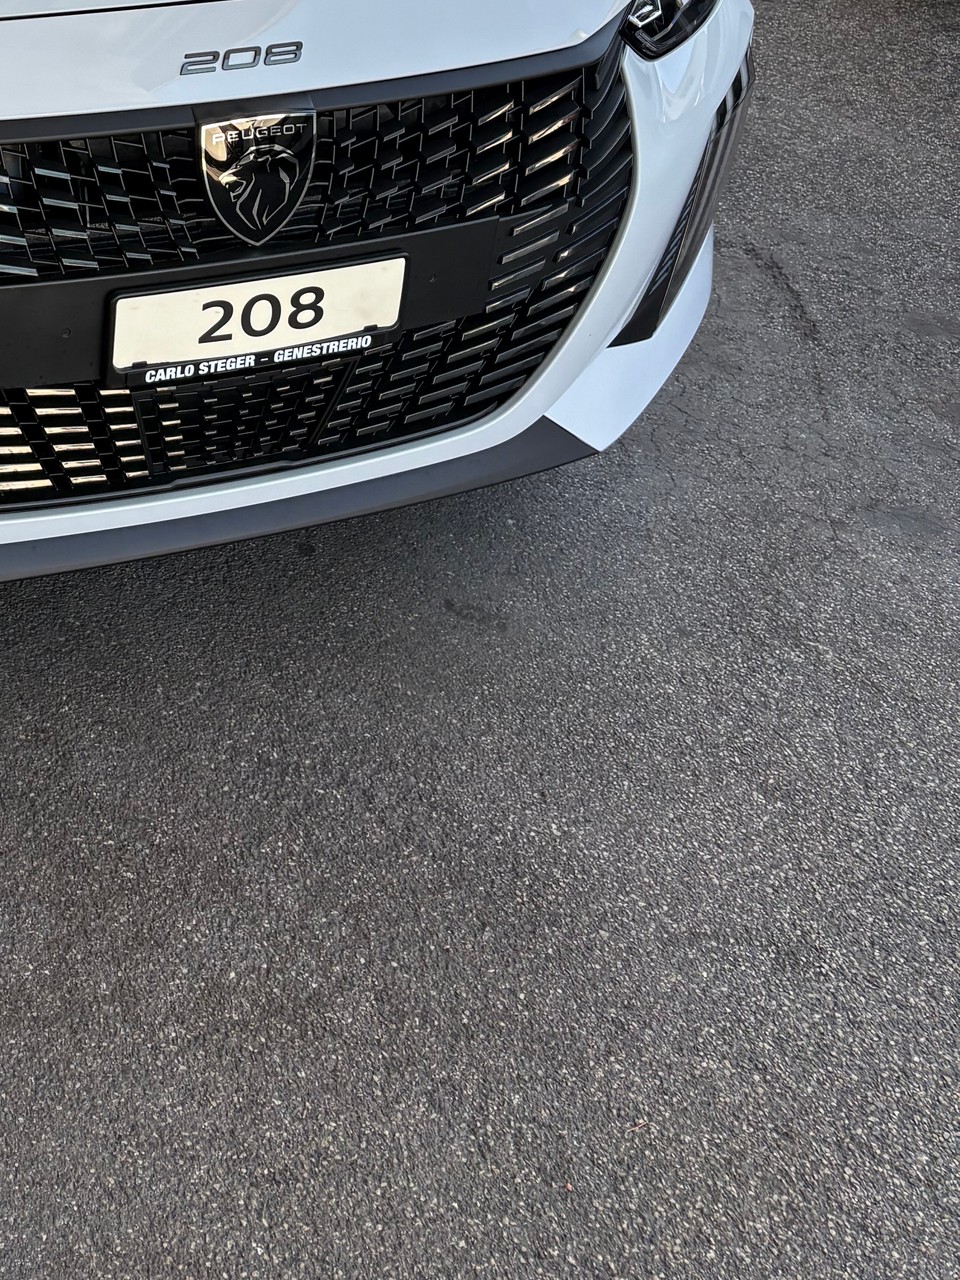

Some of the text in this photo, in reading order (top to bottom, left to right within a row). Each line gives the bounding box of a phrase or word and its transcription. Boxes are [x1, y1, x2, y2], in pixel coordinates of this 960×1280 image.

[179, 40, 303, 76] 208
[211, 122, 308, 146] PEUGEOT
[197, 286, 325, 345] 208
[145, 364, 195, 384] CARLO
[198, 354, 256, 375] STEGER
[273, 334, 373, 363] GENESTRERIO
